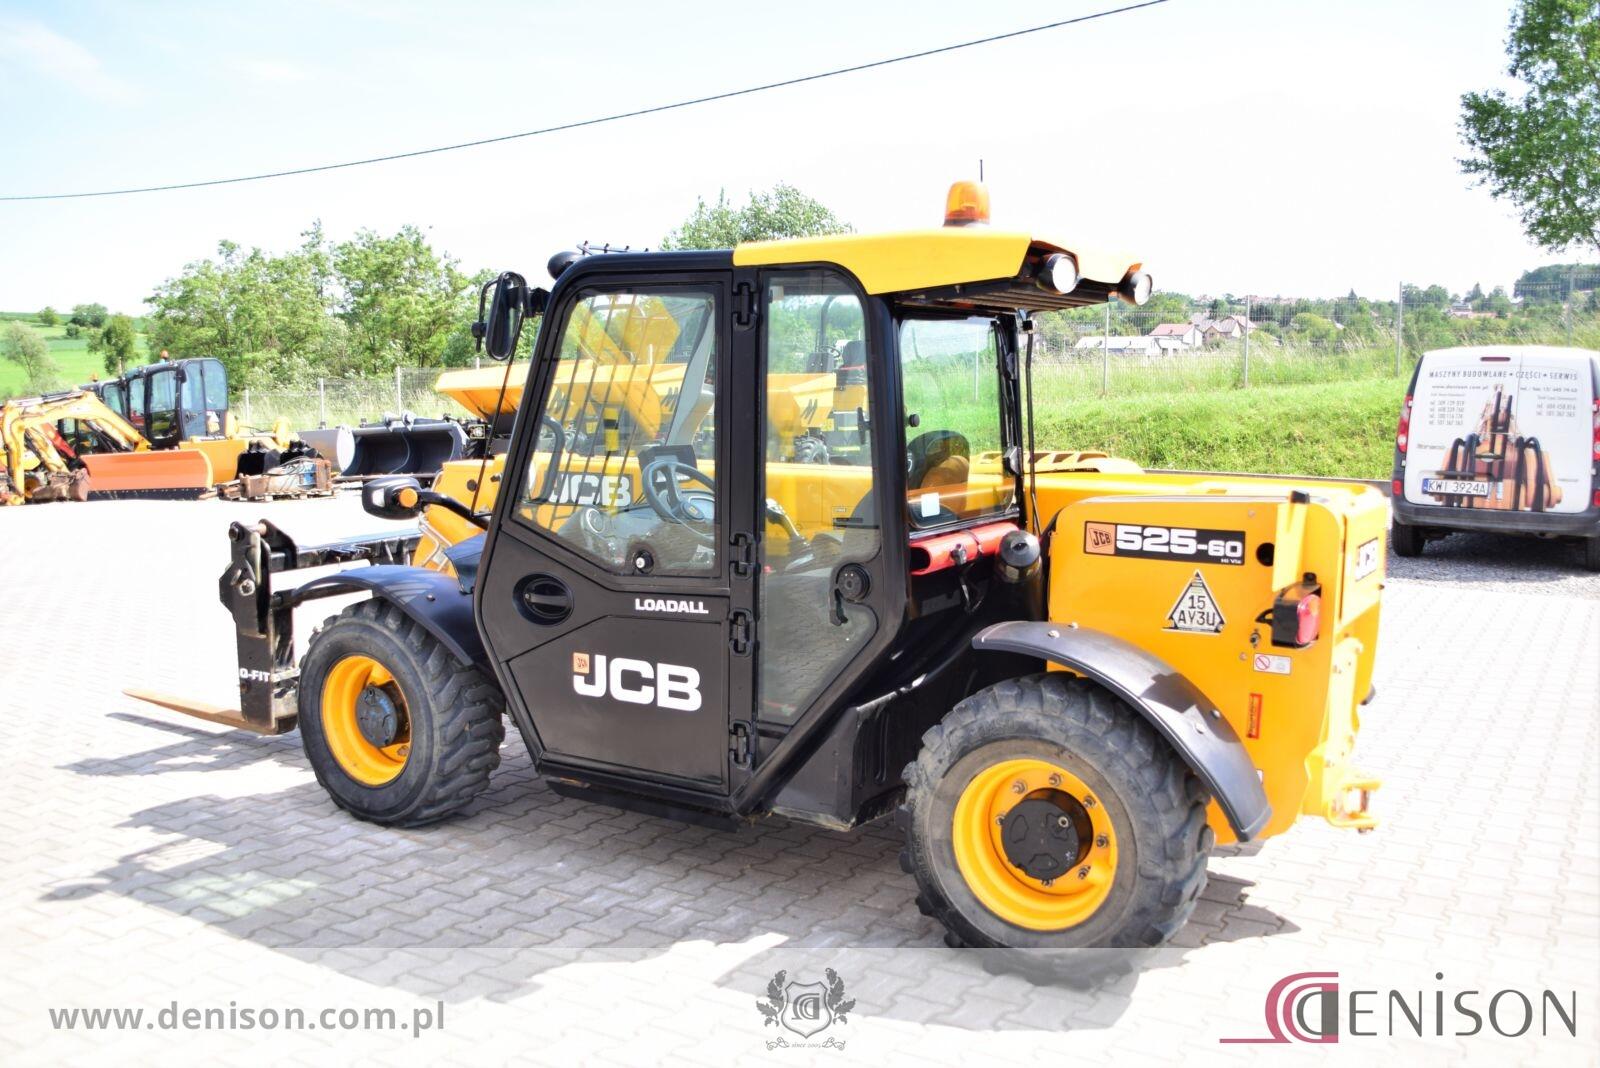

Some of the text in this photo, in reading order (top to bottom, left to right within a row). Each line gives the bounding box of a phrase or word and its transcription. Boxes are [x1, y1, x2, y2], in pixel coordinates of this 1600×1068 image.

[1429, 370, 1460, 378] MASZYNY
[1463, 370, 1508, 378] BUDOWLANE
[1549, 372, 1578, 380] SERWIS
[548, 472, 632, 507] JCB
[1428, 480, 1486, 494] KWI 3924A
[1091, 527, 1111, 547] JCB
[1116, 525, 1243, 557] 525-60
[635, 598, 709, 614] LOADALL
[1188, 595, 1206, 610] 15
[1177, 610, 1216, 626] AY3U
[573, 654, 702, 712] JCB
